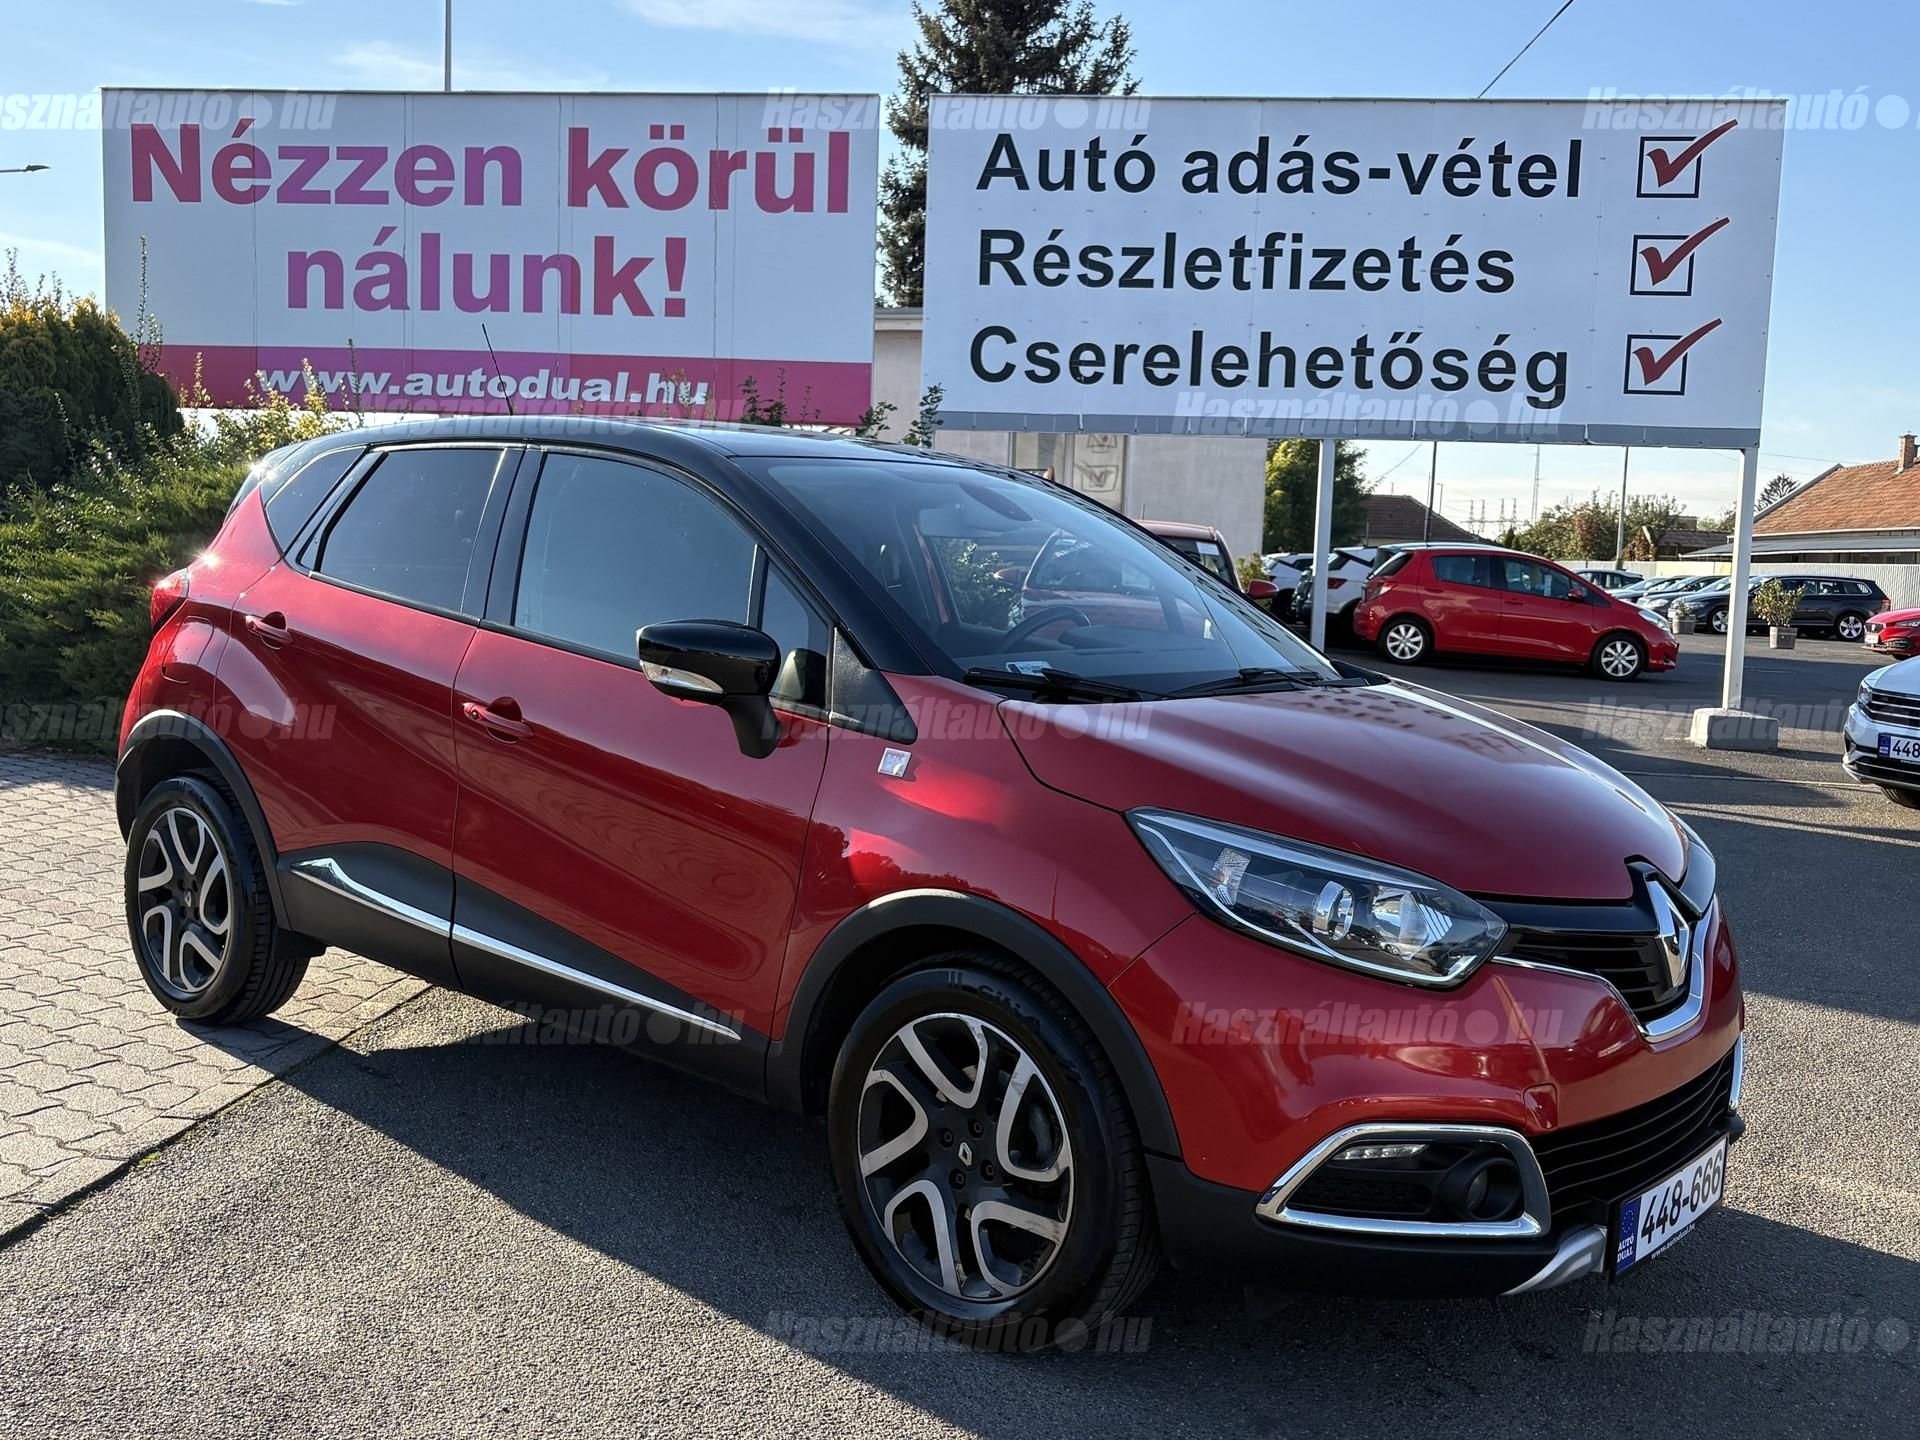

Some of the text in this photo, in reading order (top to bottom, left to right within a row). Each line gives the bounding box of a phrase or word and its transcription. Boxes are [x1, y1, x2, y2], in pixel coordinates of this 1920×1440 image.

[131, 119, 850, 213] Nézzen körül
[976, 133, 1582, 198] Autó adás-vétel
[288, 227, 687, 318] nálunk!
[977, 227, 1515, 295] Részletfizetés
[257, 366, 710, 406] www.autodual.hu
[970, 327, 1569, 409] Cserelehetőség
[1641, 1148, 1722, 1244] 448-666
